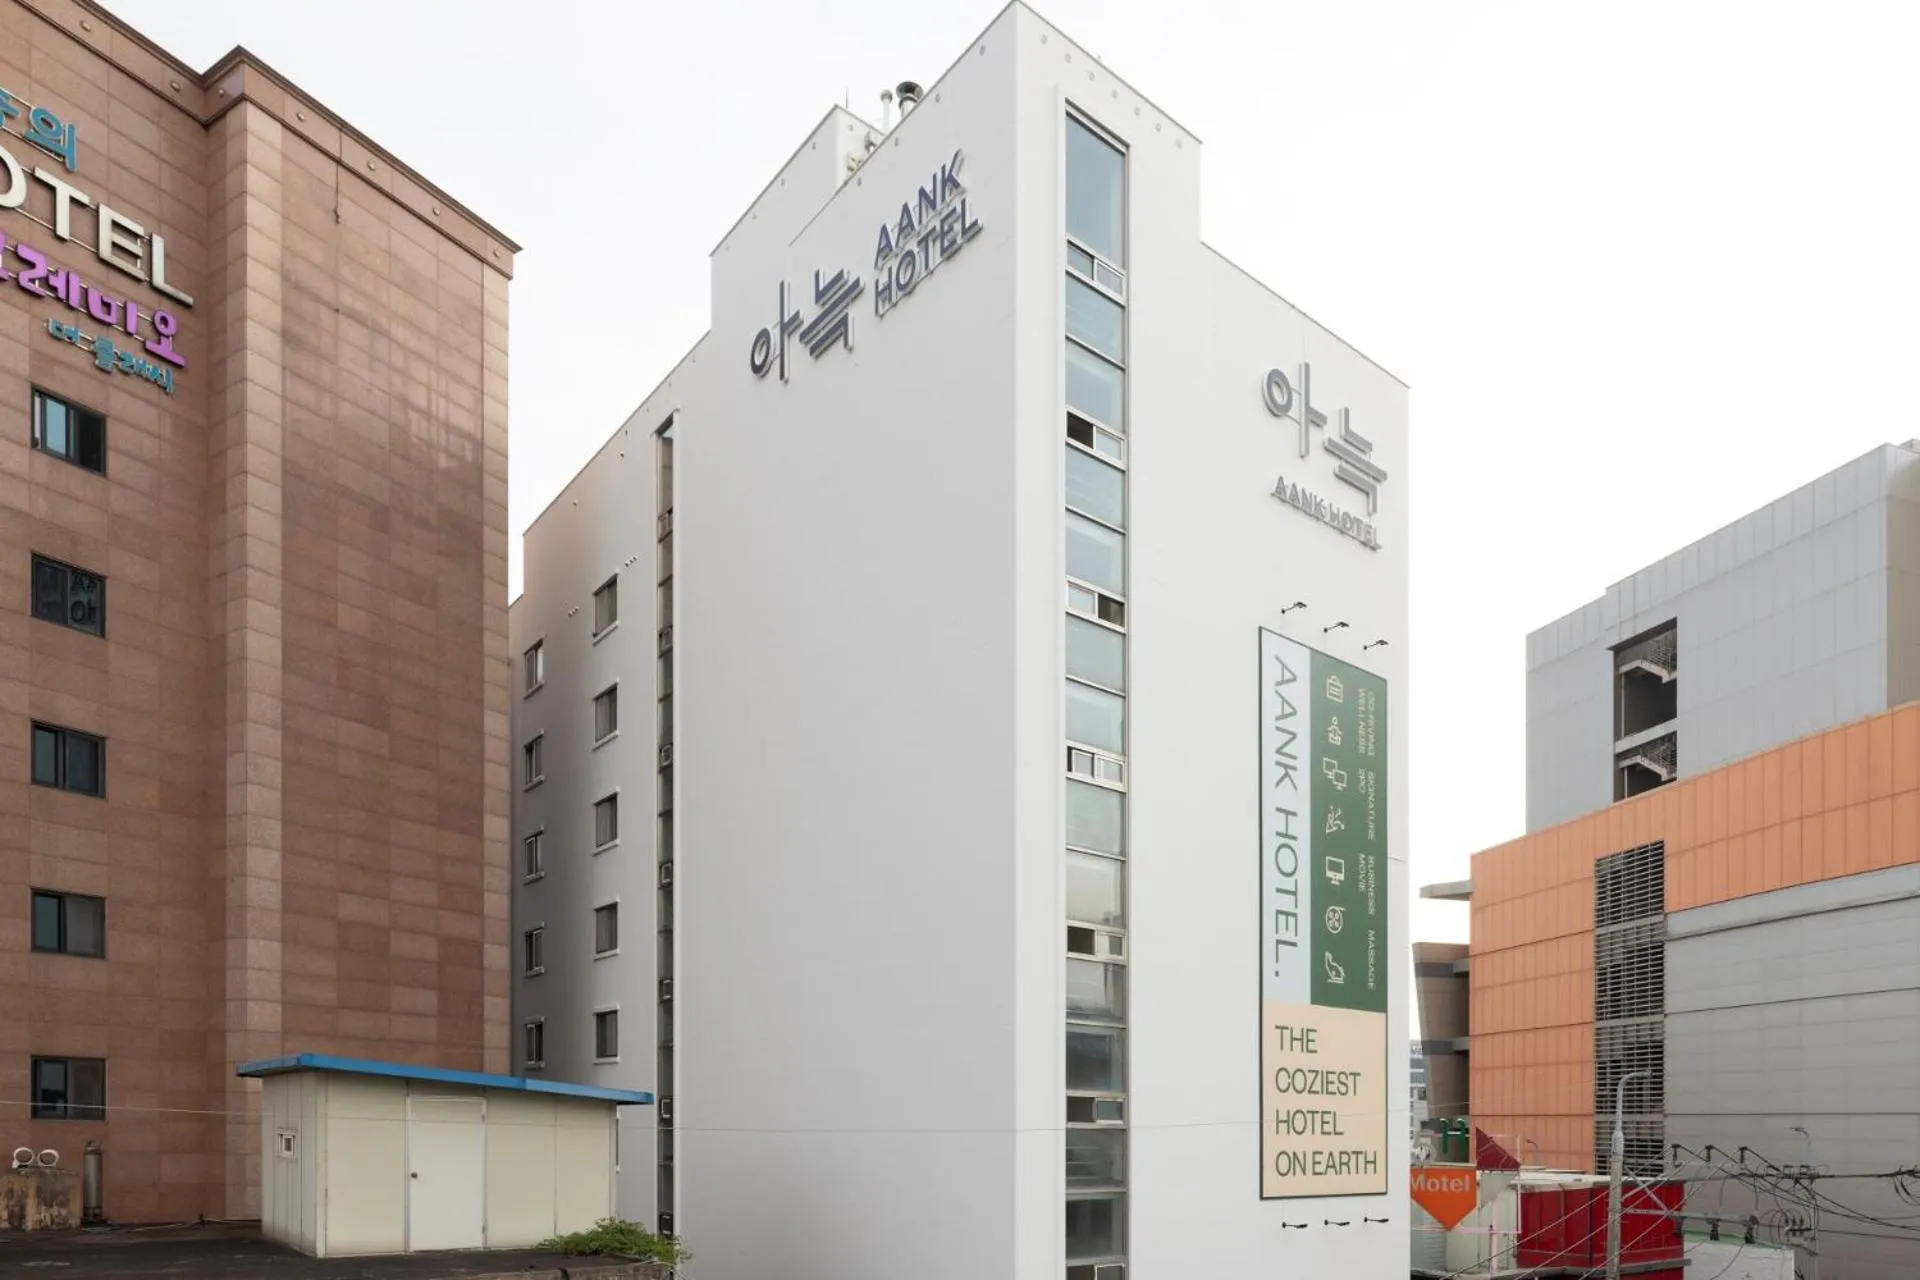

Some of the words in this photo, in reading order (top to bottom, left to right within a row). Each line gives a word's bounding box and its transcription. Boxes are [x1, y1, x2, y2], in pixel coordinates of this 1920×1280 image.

[874, 148, 965, 270] AANK
[875, 198, 982, 316] HOTEL
[0, 231, 186, 368] 레미오
[750, 267, 865, 384] 아늑
[1263, 362, 1387, 516] 아늑
[1272, 475, 1327, 521] AANK
[1328, 502, 1382, 551] HOTEL
[1274, 653, 1298, 793] AANK
[1275, 1025, 1317, 1053] THE
[1275, 1067, 1361, 1096] COZIEST
[1275, 1109, 1344, 1135] HOTEL
[1275, 1150, 1306, 1177] ON
[1312, 1150, 1377, 1176] EARTH
